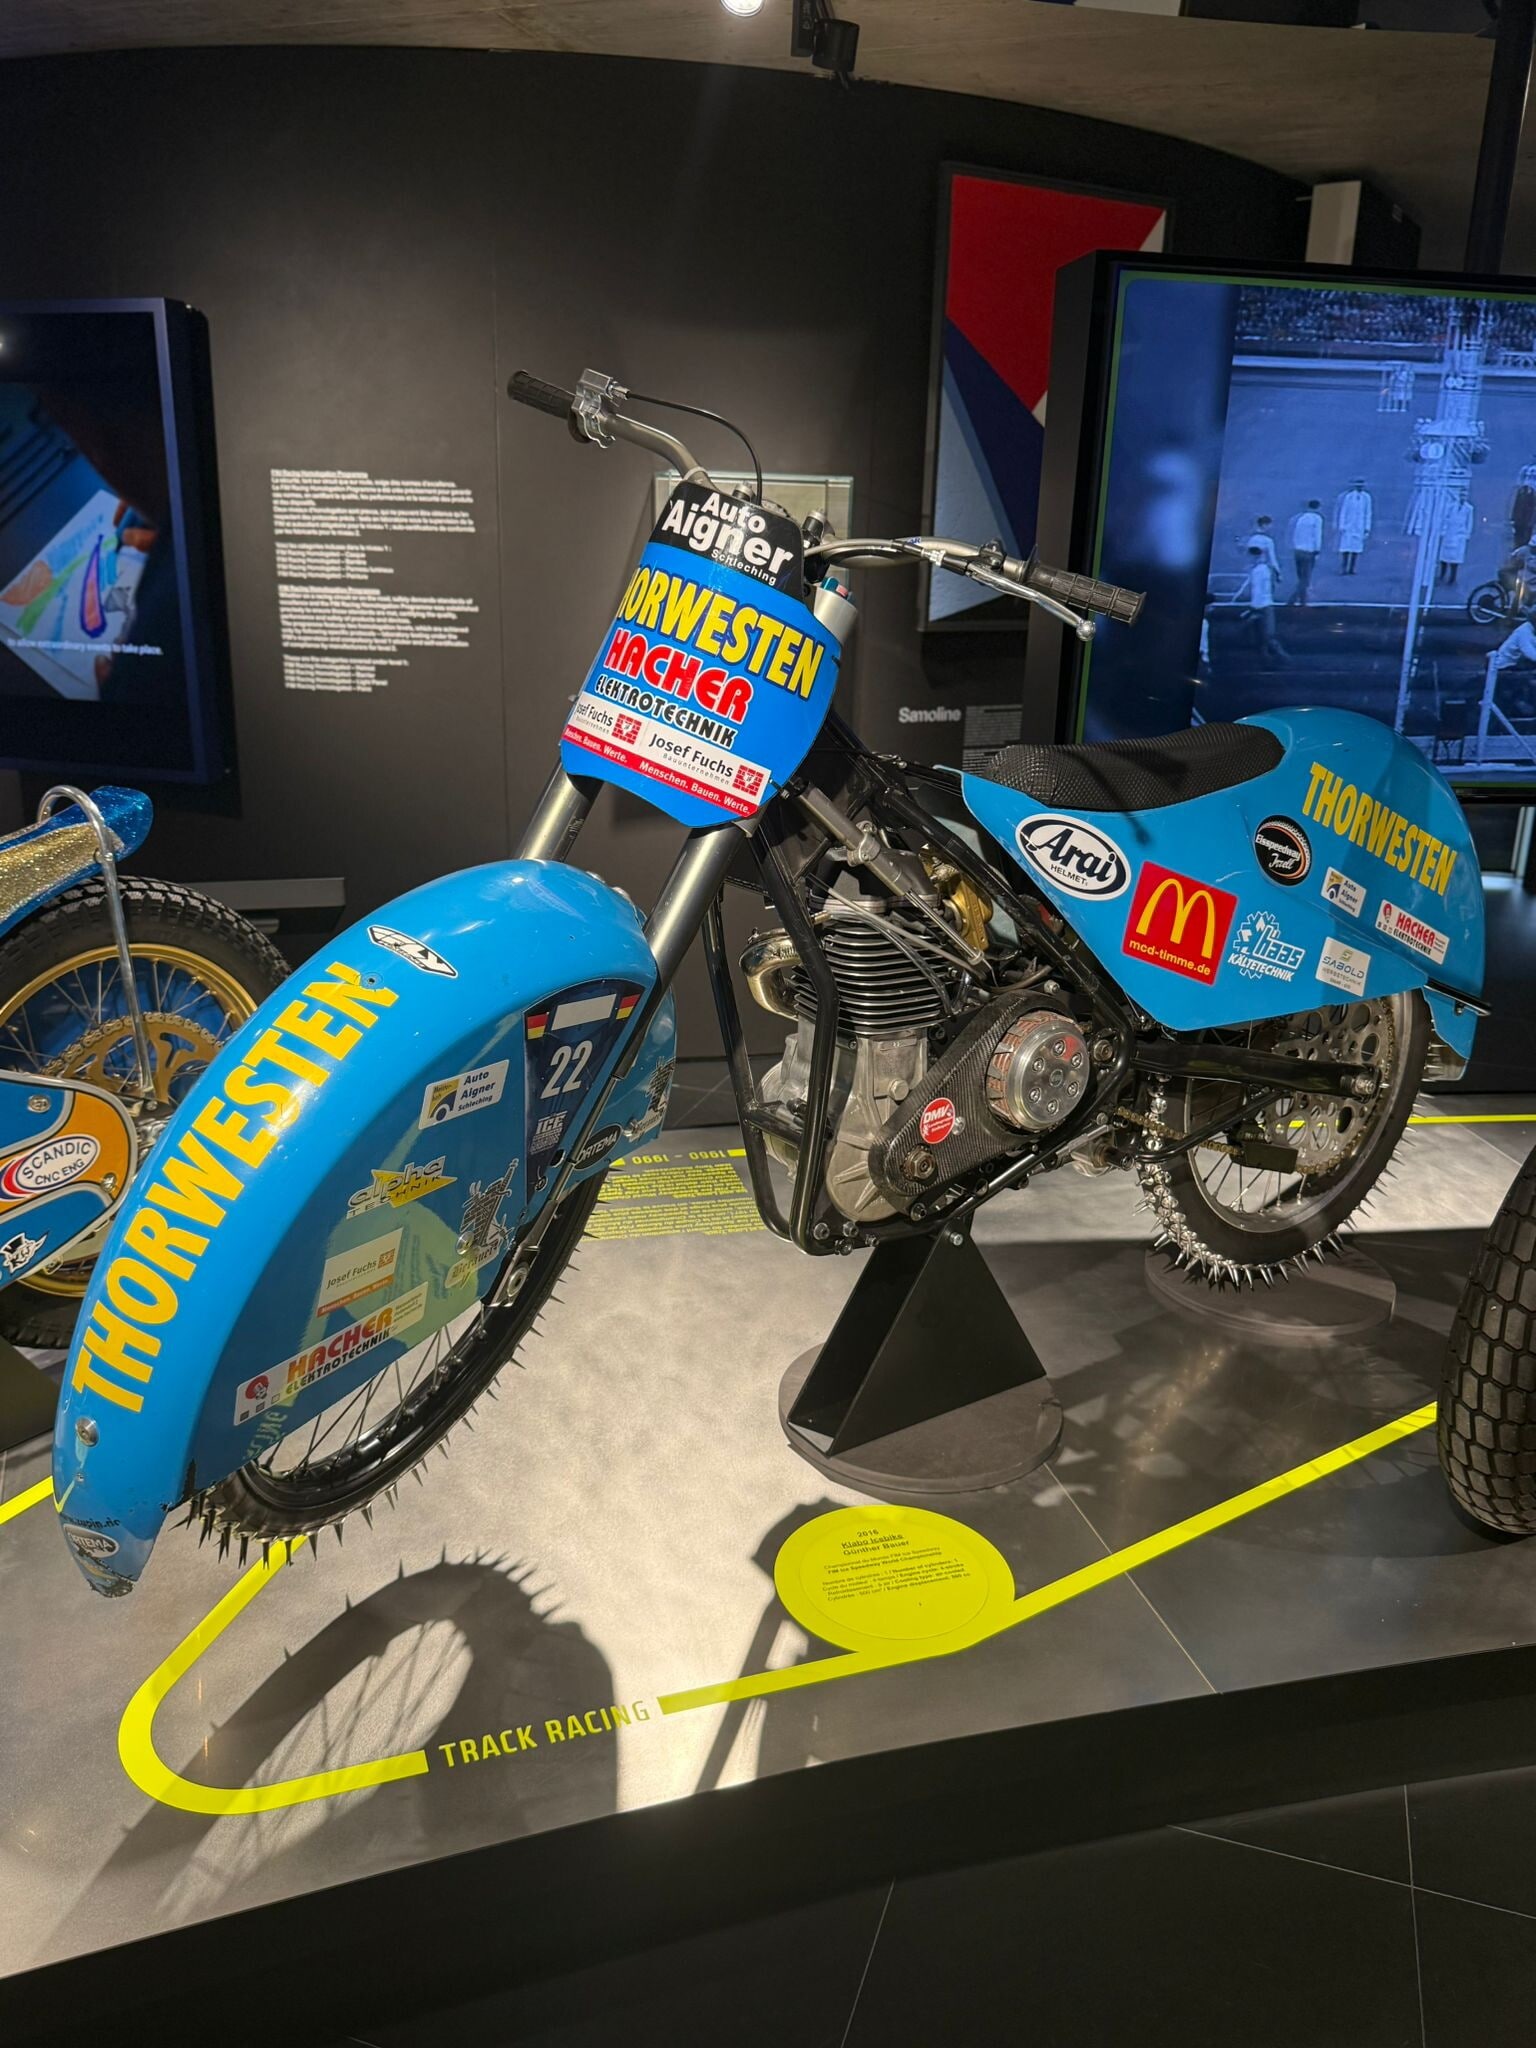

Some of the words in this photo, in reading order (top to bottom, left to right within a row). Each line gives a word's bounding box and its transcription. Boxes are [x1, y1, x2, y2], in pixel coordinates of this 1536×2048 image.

[701, 492, 766, 534] Auto
[661, 499, 794, 575] Aigner
[711, 549, 777, 586] Schleching
[616, 567, 825, 699] ORWESTEN
[603, 629, 753, 724] HACHER
[595, 675, 737, 748] ELEKTROTECHNIK
[649, 733, 692, 759] Josef
[691, 748, 734, 778] Fuchs
[639, 760, 689, 788] Menschen.
[691, 782, 721, 804] Bauen.
[723, 792, 751, 815] Werte.
[1302, 761, 1458, 896] THORWESTEN
[1028, 828, 1117, 882] Arai
[1396, 911, 1436, 948] HACHER
[1129, 939, 1211, 976] mcd-timme.de
[1228, 952, 1295, 982] KÄLTETECHNIK
[460, 1081, 496, 1101] Aigner
[463, 1070, 489, 1086] Auto
[541, 1040, 593, 1099] 22
[923, 1103, 950, 1124] DMV
[22, 1141, 92, 1180] SCANDIC
[35, 1169, 60, 1185] CNC
[62, 1158, 84, 1177] ENG
[71, 961, 400, 1414] THORWESTEN
[326, 1269, 351, 1290] Josef
[352, 1260, 377, 1277] Fuchs
[285, 1326, 391, 1395] ELEKTROTECHNIK
[287, 1307, 393, 1381] HACHER
[857, 1528, 880, 1538] 2016
[438, 1724, 538, 1768] TRACK
[544, 1700, 651, 1744] RACING
